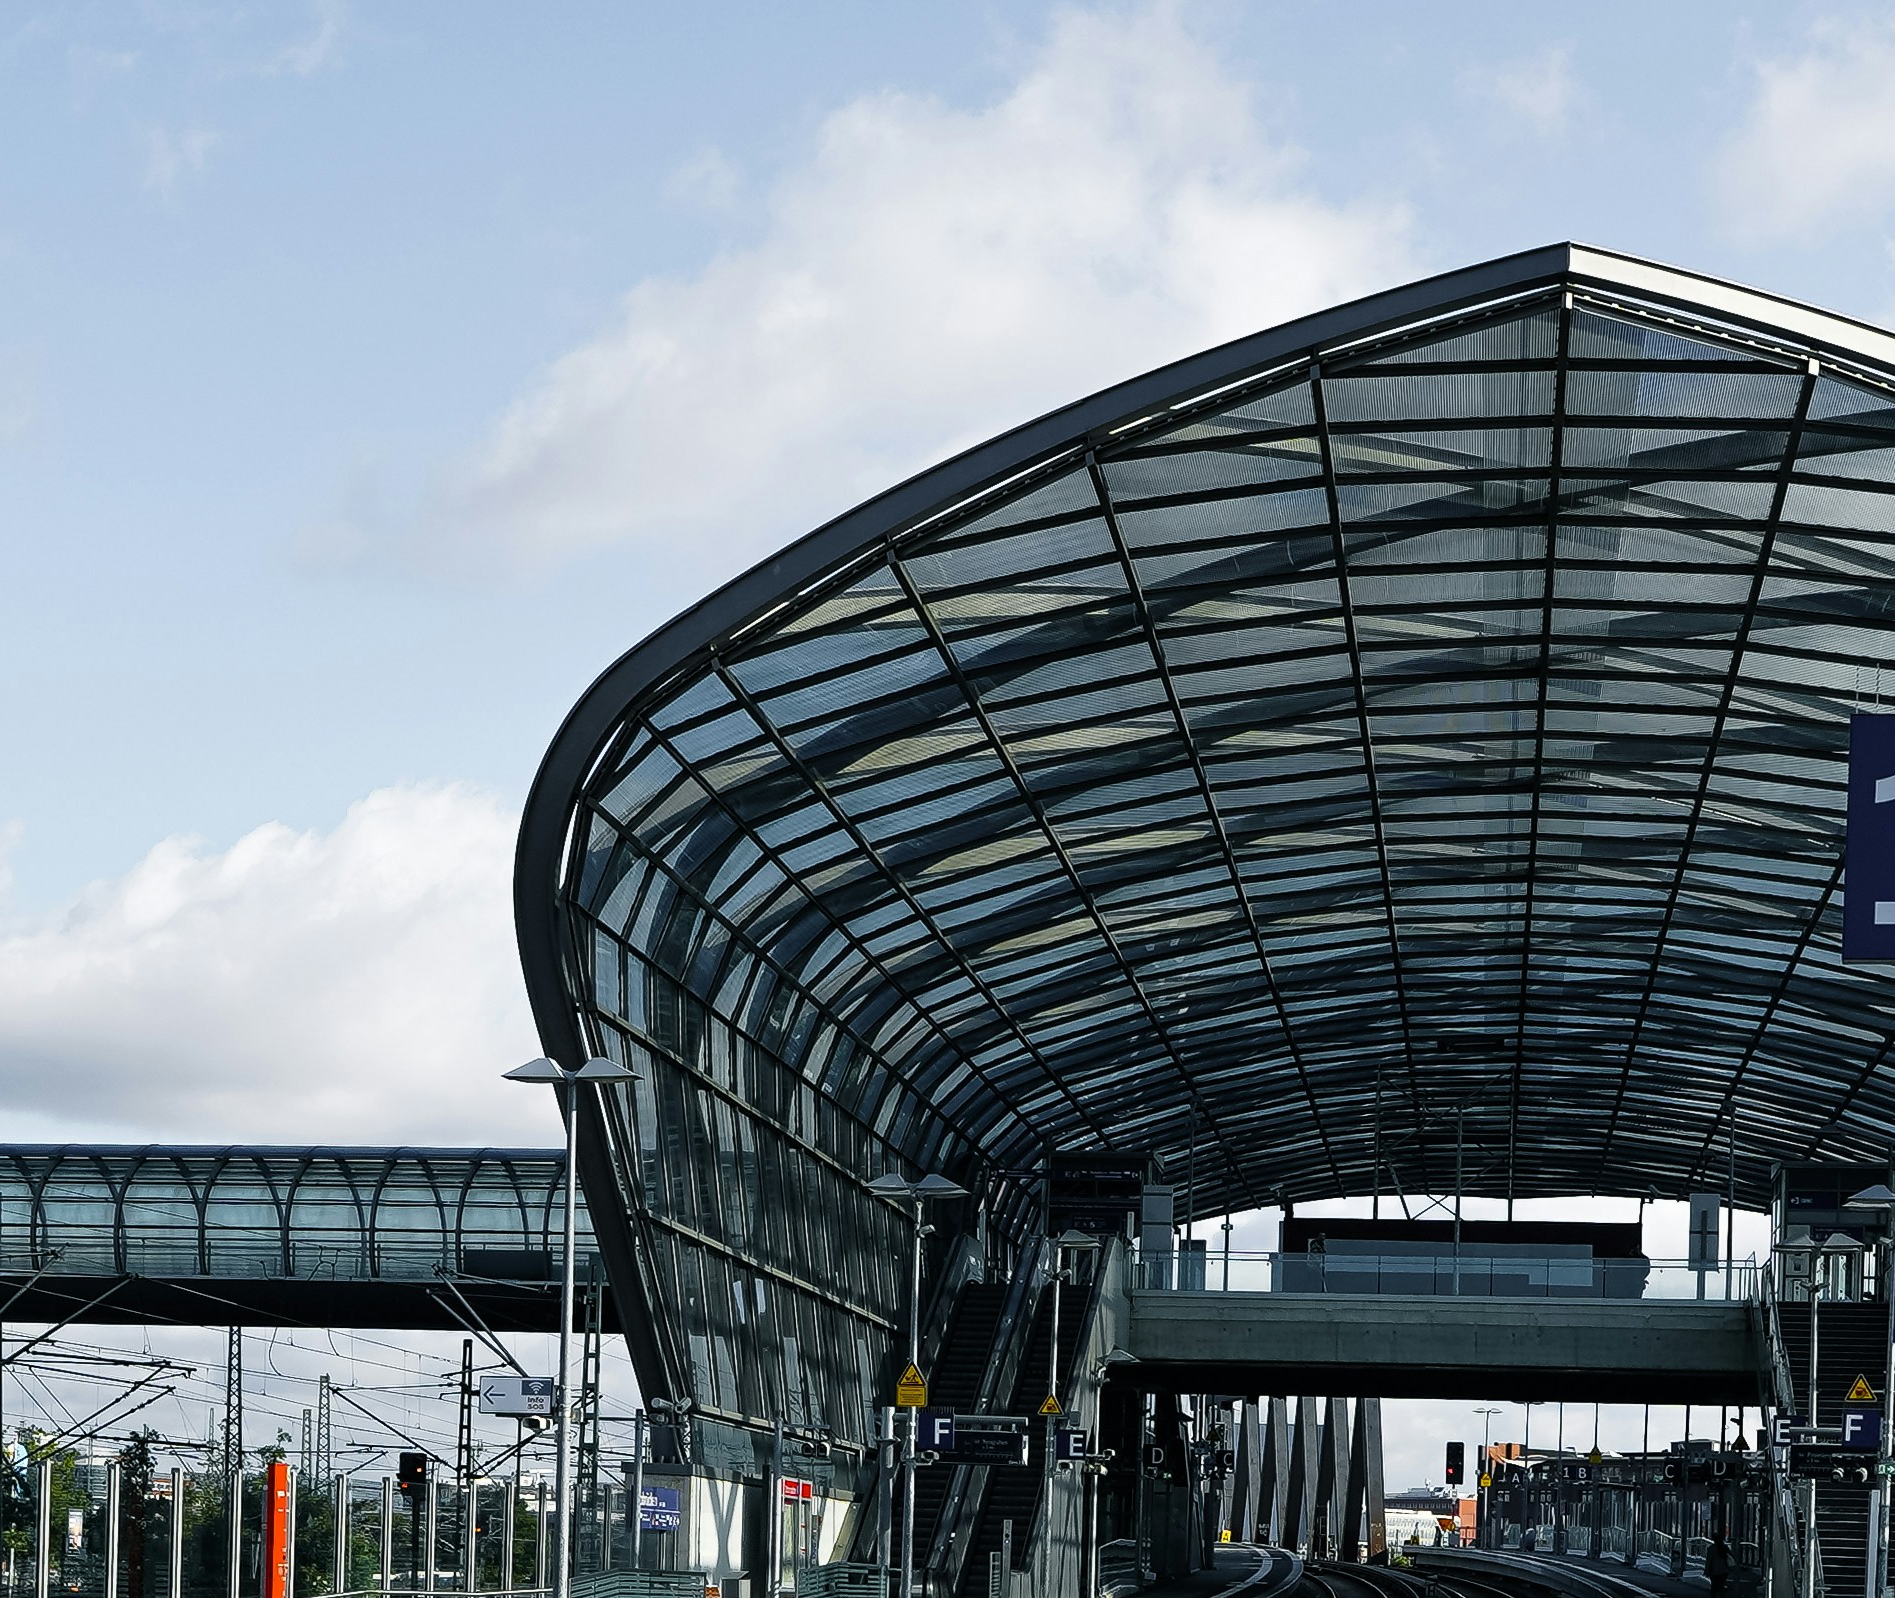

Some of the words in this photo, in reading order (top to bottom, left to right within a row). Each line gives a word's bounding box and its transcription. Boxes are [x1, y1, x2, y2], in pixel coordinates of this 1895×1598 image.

[934, 1418, 951, 1445] F
[1775, 1419, 1791, 1443] E
[1845, 1414, 1864, 1442] F
[1069, 1434, 1084, 1457] E
[1152, 1447, 1164, 1464] D
[1223, 1452, 1233, 1466] C
[1562, 1466, 1570, 1478] 1
[1578, 1467, 1587, 1479] B
[1664, 1464, 1675, 1478] C
[1714, 1460, 1727, 1476] D
[1511, 1472, 1520, 1483] A
